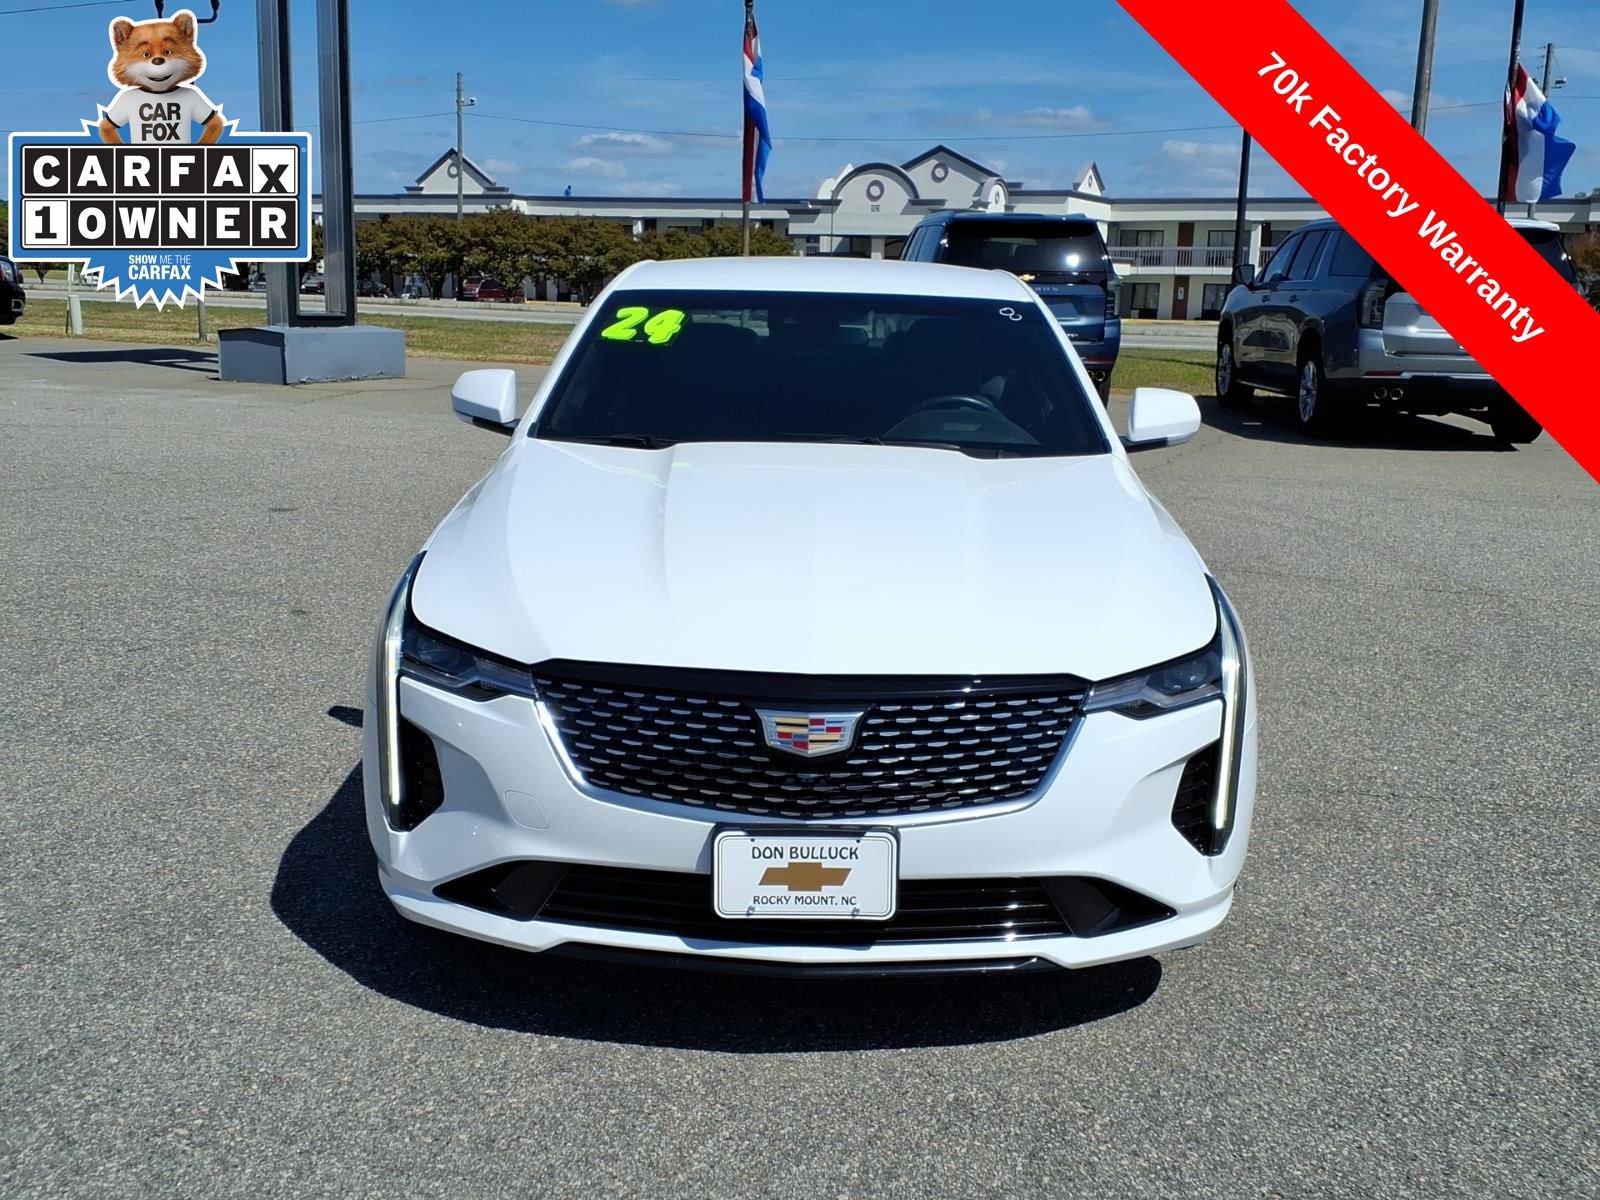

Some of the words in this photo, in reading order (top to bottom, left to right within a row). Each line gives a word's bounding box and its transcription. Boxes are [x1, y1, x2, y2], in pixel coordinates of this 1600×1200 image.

[601, 306, 686, 345] 24
[751, 846, 785, 860] DON
[789, 846, 860, 861] BULLUCK
[753, 895, 792, 906] ROCKY
[841, 896, 857, 906] NC
